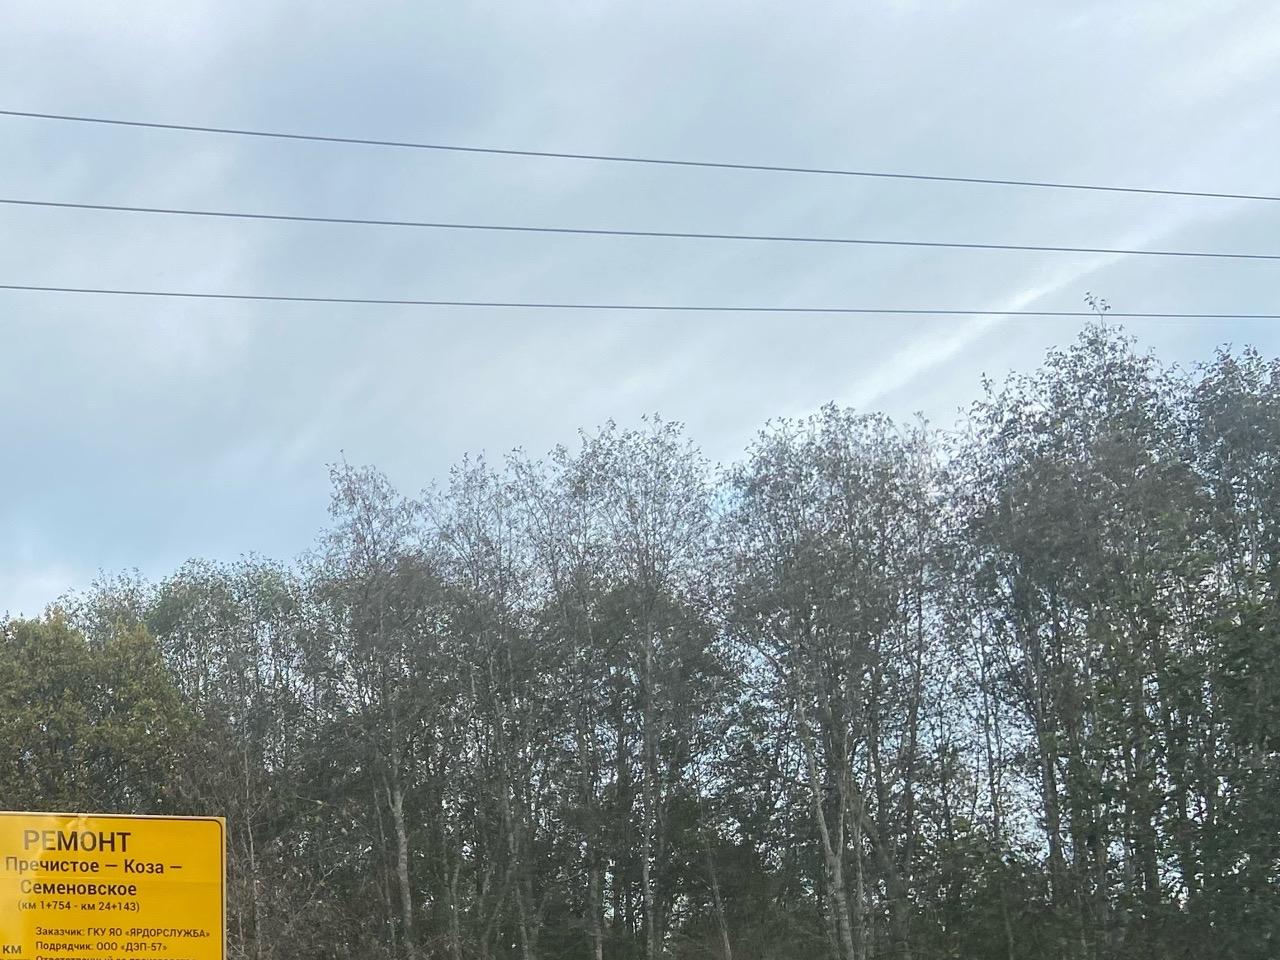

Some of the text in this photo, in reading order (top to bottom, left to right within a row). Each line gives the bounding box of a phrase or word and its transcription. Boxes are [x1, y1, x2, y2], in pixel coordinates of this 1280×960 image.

[23, 829, 131, 852] РЕМОНТ
[5, 856, 99, 874] Пречистое
[124, 859, 164, 874] Коза
[20, 880, 137, 896] Семеновское
[18, 900, 36, 911] (км
[40, 900, 71, 910] 1+754
[81, 902, 96, 910] км
[98, 902, 140, 912] 24+143)
[36, 926, 210, 938] Заказчик: ГКУ ЯО «ЯРДОРСЛУЖБА»
[36, 941, 167, 952] Подрядчик: ООО «ДЭП-57»
